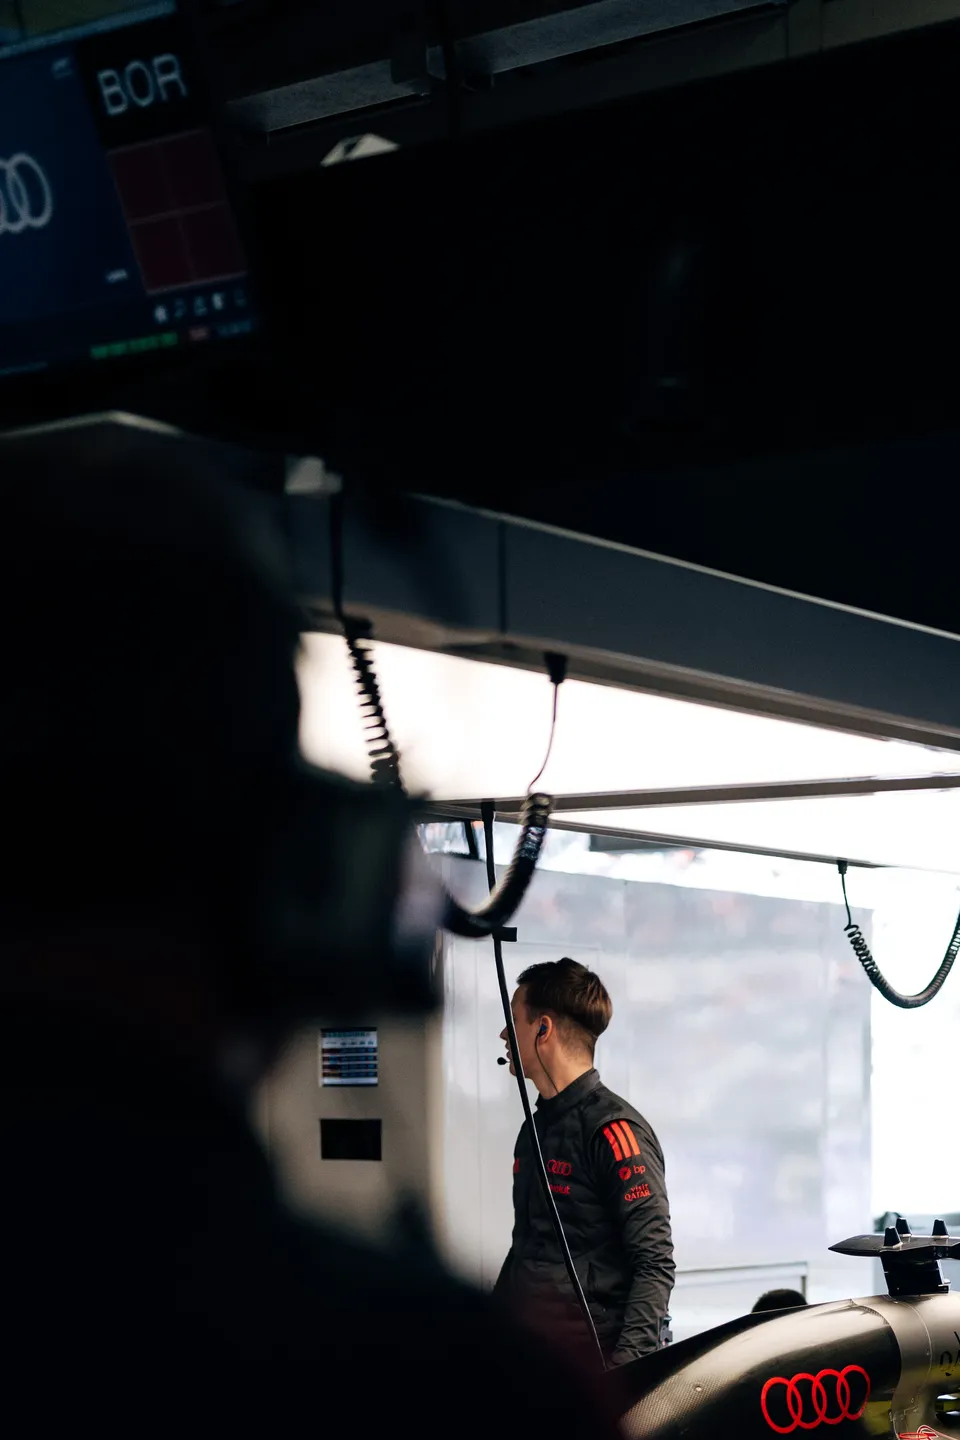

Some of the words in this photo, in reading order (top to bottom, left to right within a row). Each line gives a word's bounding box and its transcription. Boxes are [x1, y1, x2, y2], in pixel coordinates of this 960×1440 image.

[96, 52, 189, 117] BOR
[633, 1164, 646, 1175] bp
[624, 1189, 652, 1202] QATAR
